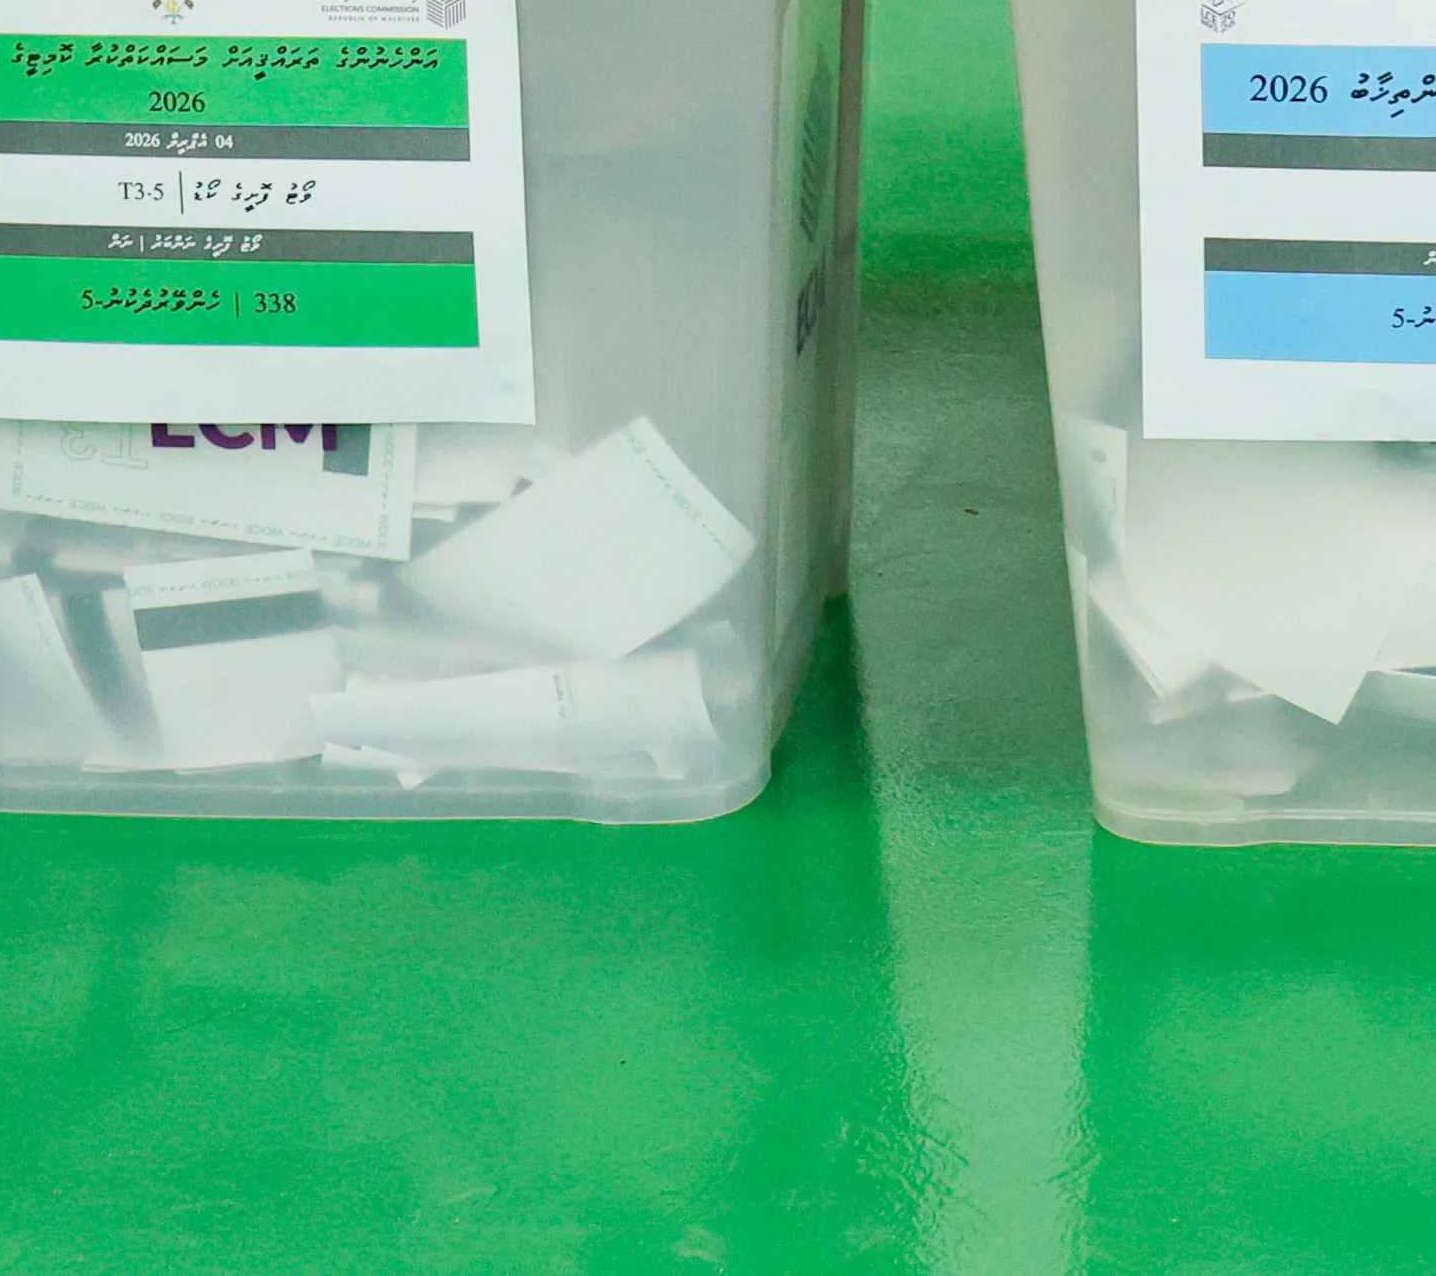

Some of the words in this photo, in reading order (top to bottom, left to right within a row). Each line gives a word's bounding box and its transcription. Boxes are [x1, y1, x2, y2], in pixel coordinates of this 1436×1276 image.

[321, 5, 365, 13] ELECTIONS
[366, 5, 420, 13] COMMISSION
[1249, 74, 1328, 103] 2026
[149, 91, 205, 113] 2026
[124, 132, 161, 147] 2026
[215, 134, 234, 148] 04
[254, 292, 297, 314] 338
